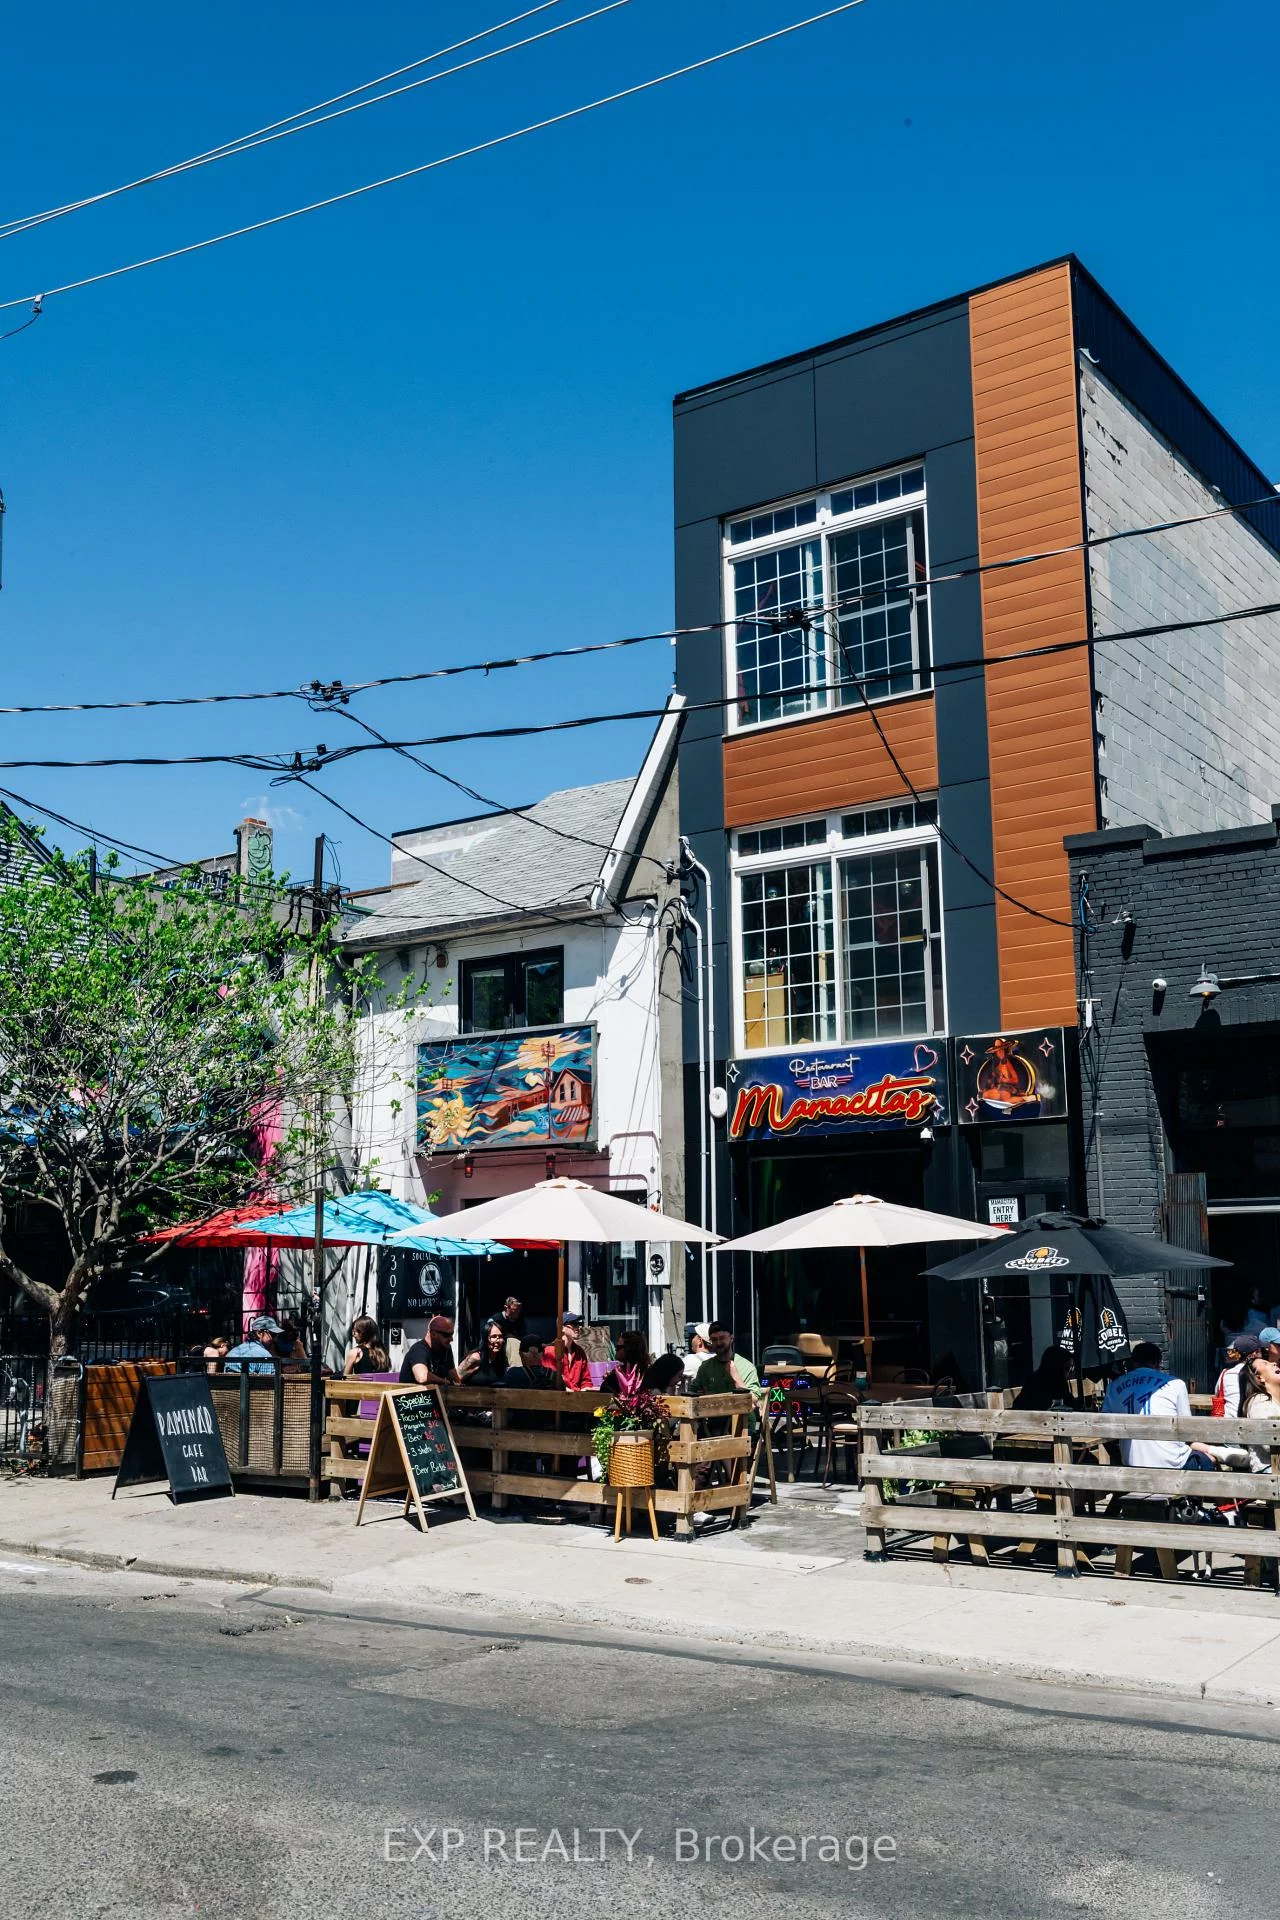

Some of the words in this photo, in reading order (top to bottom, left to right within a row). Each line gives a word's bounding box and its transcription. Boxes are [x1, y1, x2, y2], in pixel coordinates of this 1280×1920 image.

[789, 1053, 861, 1078] Restaurant
[811, 1075, 838, 1090] BAR
[730, 1073, 936, 1137] Mamacitas
[992, 1205, 1014, 1214] ENTRY
[995, 1214, 1013, 1223] HERE
[1009, 1257, 1064, 1267] COWBELL
[407, 1298, 417, 1307] NO
[182, 1443, 204, 1458] CAFE
